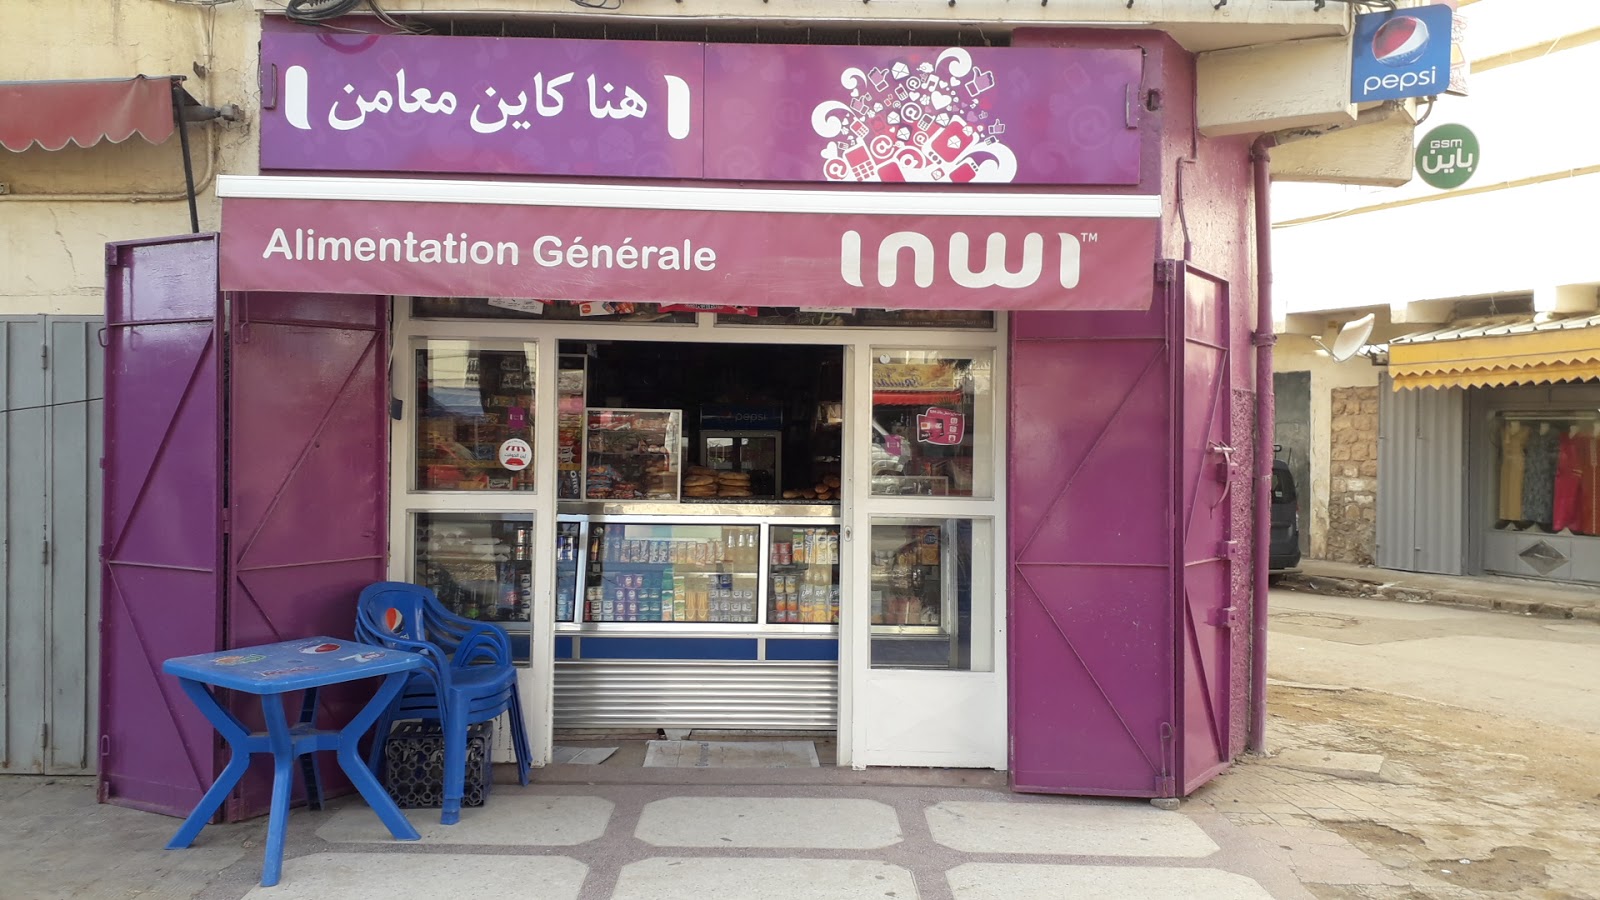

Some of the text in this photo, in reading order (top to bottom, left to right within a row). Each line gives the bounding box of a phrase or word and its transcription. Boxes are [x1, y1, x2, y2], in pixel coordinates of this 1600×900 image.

[1363, 66, 1437, 96] pepsi
[328, 68, 648, 135] هنا كاين معامن
[1430, 138, 1463, 148] GSM
[1422, 148, 1473, 174] باين
[262, 228, 717, 271] Alimentation Générale
[735, 412, 766, 423] pepsi
